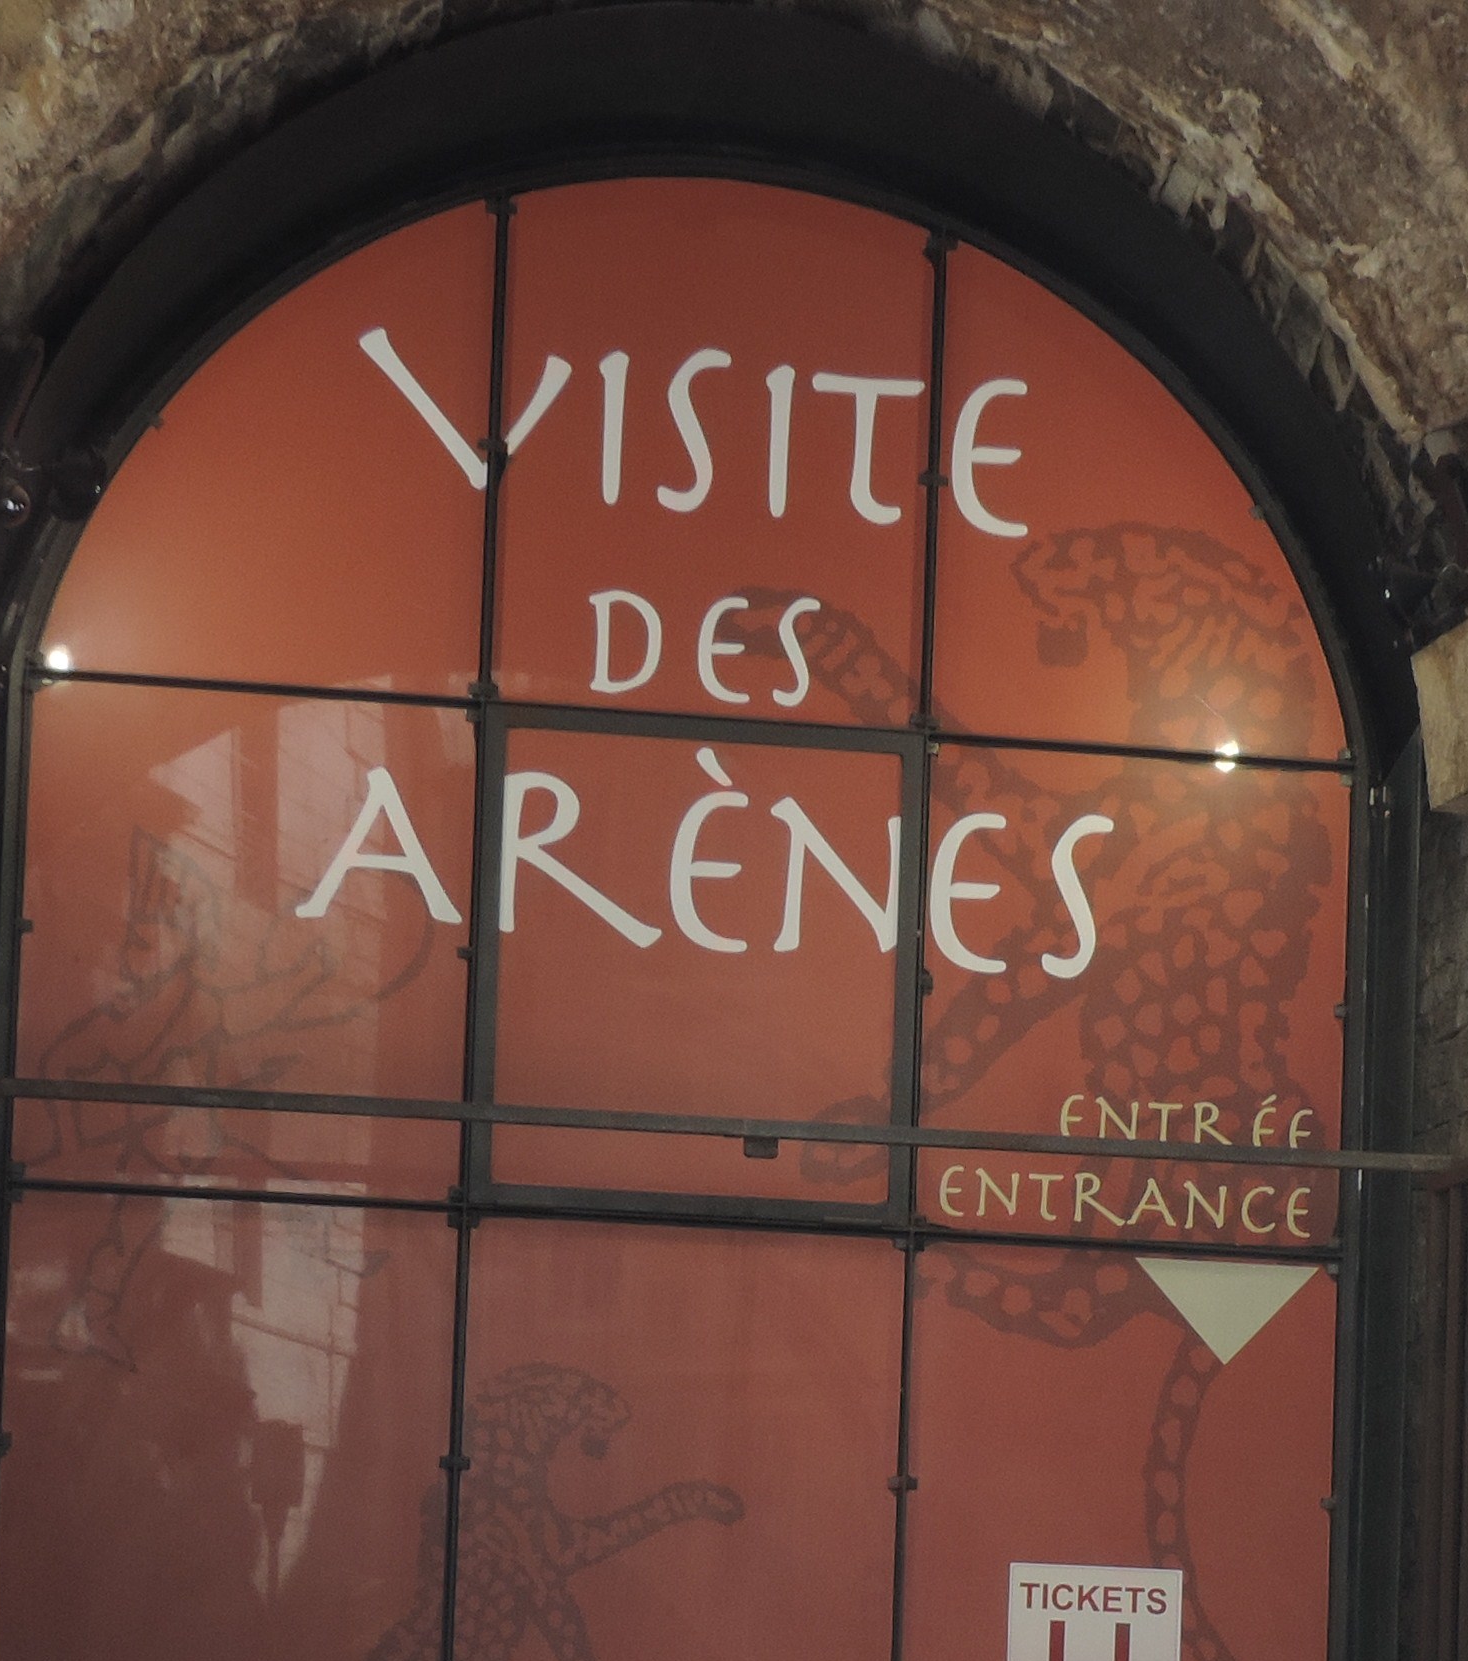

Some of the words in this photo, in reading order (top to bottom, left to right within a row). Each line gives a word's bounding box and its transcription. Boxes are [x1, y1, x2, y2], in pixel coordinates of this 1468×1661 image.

[359, 326, 1029, 538] VISITE
[588, 590, 821, 708] DES
[295, 747, 1115, 980] ARÈNES
[1059, 1094, 1313, 1149] ENTRÉE
[939, 1165, 1311, 1239] ENTRANCE
[1019, 1582, 1167, 1616] TICKETS
